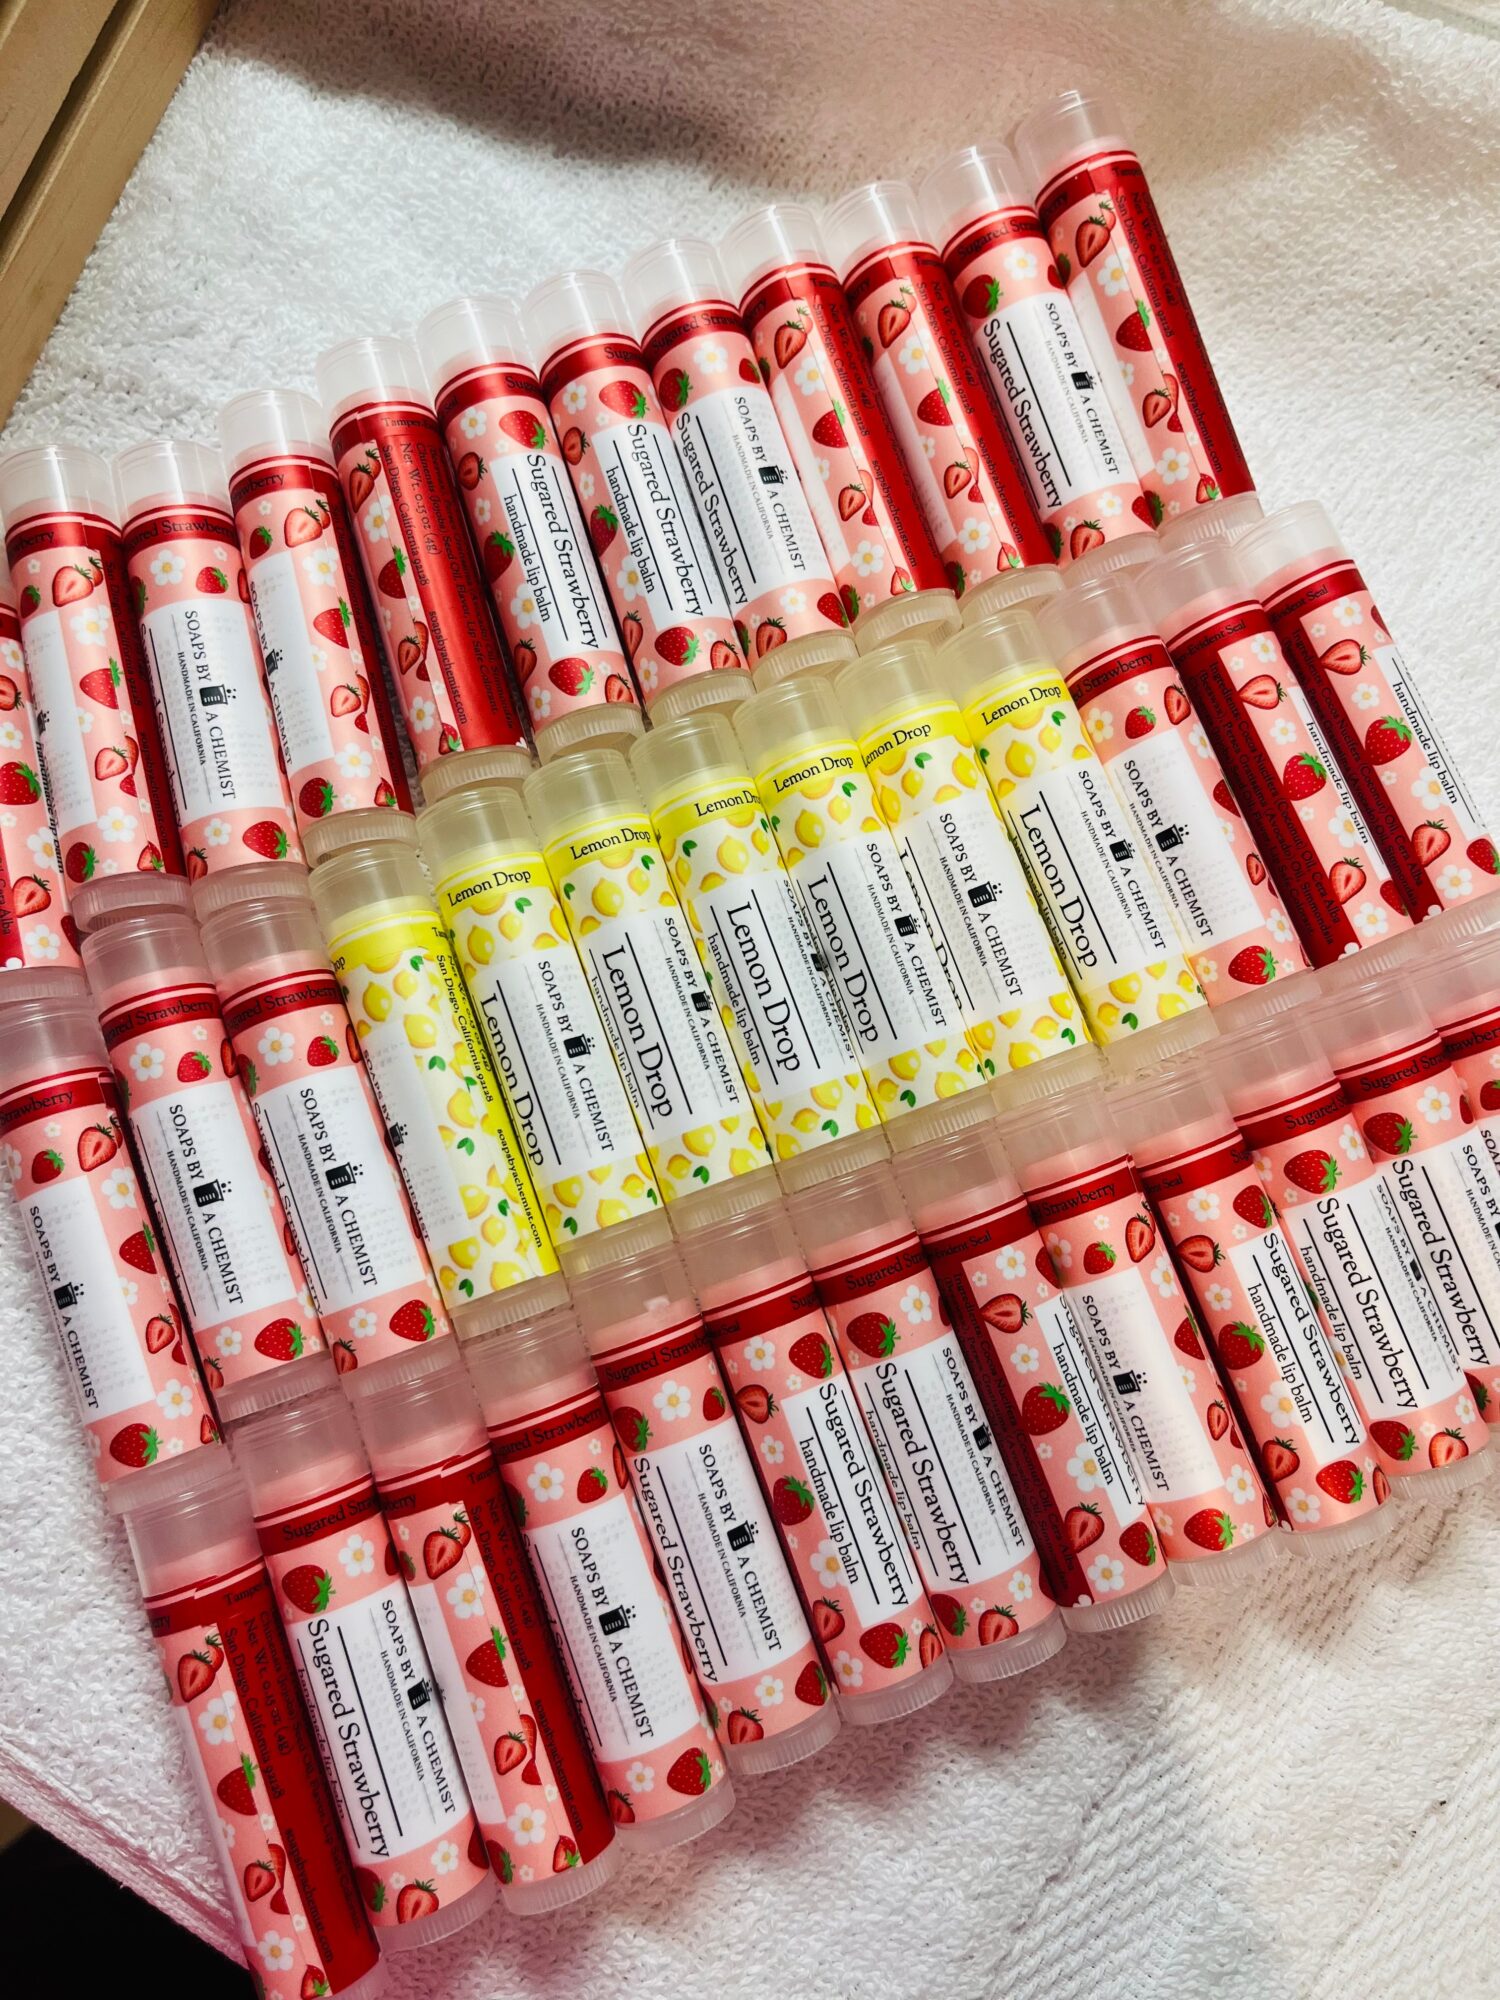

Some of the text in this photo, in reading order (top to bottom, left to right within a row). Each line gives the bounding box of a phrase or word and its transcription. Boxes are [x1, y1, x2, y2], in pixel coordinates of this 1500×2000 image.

[984, 319, 1062, 509] Sugared Strawberry
[1045, 302, 1120, 475] SOAPS BY A CHEMIST
[504, 495, 550, 623] handmade lip balm
[527, 454, 599, 649] Sugared Strawberry
[606, 467, 655, 594] handmade lip balm
[627, 424, 703, 618] Sugared Strawberry
[676, 412, 748, 605] Sugared Strawberry
[735, 396, 805, 571] SOAPS BY A CHEMIST
[177, 651, 194, 701] HANDMADE
[190, 711, 206, 766] CALIFORNIA
[186, 610, 236, 799] SOAPS BY A CHEMIST
[774, 756, 853, 793] Lemon Drop
[893, 723, 931, 745] Drop
[982, 685, 1062, 725] Lemon Drop
[1392, 681, 1458, 804] handmade lip balm
[448, 870, 531, 907] Lemon Drop
[570, 828, 651, 861] Lemon Drop
[694, 797, 743, 818] Lemon
[1019, 805, 1098, 968] Lemon Drop
[1078, 770, 1166, 950] SOAPS BY A CHEMIST
[1125, 760, 1214, 937] SOAPS BY A CHEMIST
[727, 902, 800, 1073] Lemon Drop
[809, 875, 849, 971] Lemon
[845, 970, 878, 1043] Drop
[867, 843, 946, 1027] SOAPS BY A CHEMIST
[939, 856, 963, 904] HANDMADE
[962, 913, 987, 966] CALIFORNIA
[940, 813, 1022, 996] SOAPS BY A CHEMIST
[436, 954, 494, 1102] San Diego, California 92128
[480, 992, 546, 1167] Lemon Drop
[538, 961, 614, 1152] SOAPS BY A CHEMIST
[602, 945, 673, 1118] Lemon Drop
[664, 917, 739, 1104] SOAPS BY A CHEMIST
[708, 932, 760, 1065] handmade lip balm
[30, 1206, 51, 1261] SOAPS
[47, 1260, 60, 1283] BY
[167, 1150, 188, 1204] HANDMADE
[185, 1214, 207, 1271] CALIFORNIA
[170, 1104, 243, 1305] SOAPS BY A CHEMIST
[301, 1088, 378, 1287] SOAPS BY A CHEMIST
[1393, 1158, 1490, 1366] Sugared Strawberry
[62, 1316, 72, 1329] A
[66, 1332, 98, 1410] CHEMIST
[1248, 1283, 1312, 1424] handmade lip balm
[1263, 1232, 1360, 1445] Sugared Strawberry
[1317, 1197, 1418, 1410] Sugared Strawberry
[876, 1363, 969, 1585] Sugared Strawberry
[942, 1347, 1025, 1547] SOAPS BY A CHEMIST
[1083, 1295, 1169, 1491] SOAPS BY A CHEMIST
[633, 1457, 719, 1683] Sugared Strawberry
[698, 1493, 722, 1550] HANDMADE
[722, 1560, 746, 1618] CALIFORNIA
[699, 1444, 782, 1652] SOAPS BY A CHEMIST
[799, 1439, 858, 1584] handmade lip balm
[820, 1383, 909, 1606] Sugared Strawberry
[382, 1600, 454, 1814] SOAPS BY A CHEMIST
[571, 1527, 653, 1739] SOAPS BY A CHEMIST
[307, 1618, 390, 1858] Sugared Strawberry
